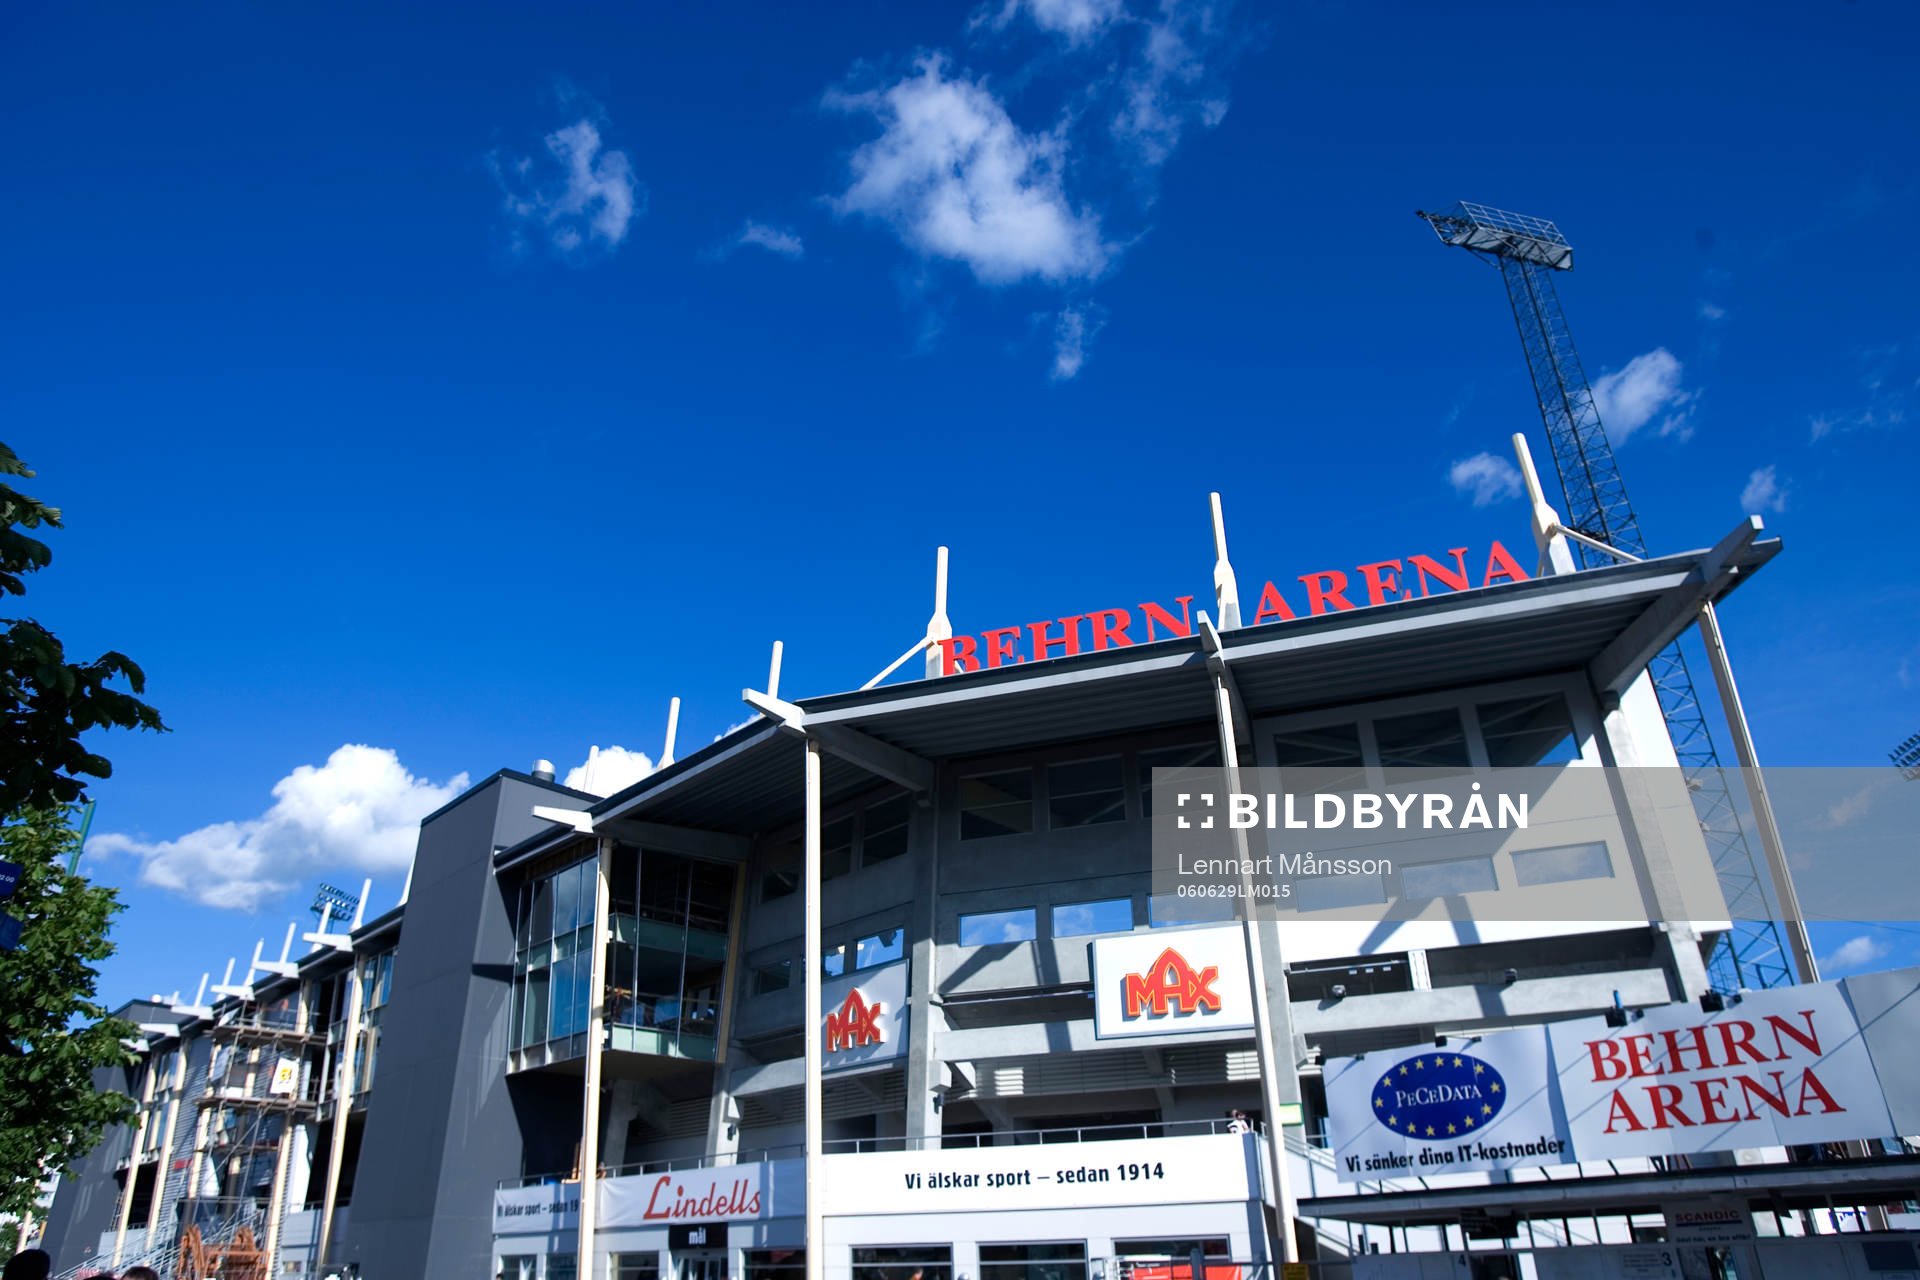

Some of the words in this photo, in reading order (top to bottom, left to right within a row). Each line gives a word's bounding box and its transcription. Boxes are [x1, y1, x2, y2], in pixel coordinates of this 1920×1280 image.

[937, 596, 1194, 676] BEHRN
[1252, 540, 1530, 626] ARENA
[1125, 947, 1222, 1018] MAX
[827, 988, 883, 1053] MAX
[1583, 1010, 1823, 1083] BEHRN
[1603, 1066, 1848, 1134] ARENA
[905, 1173, 921, 1189] Vi
[928, 1172, 980, 1189] älskar
[986, 1169, 1031, 1188] sport
[1056, 1166, 1110, 1184] sedan
[1117, 1162, 1165, 1181] 1914
[1346, 1155, 1361, 1173] Vi
[1365, 1152, 1415, 1171] sänker
[1419, 1147, 1455, 1167] dina
[1458, 1136, 1566, 1163] IT-kostnader
[643, 1175, 761, 1220] Lindells
[1458, 1253, 1467, 1267] 4
[1662, 1251, 1673, 1266] 3
